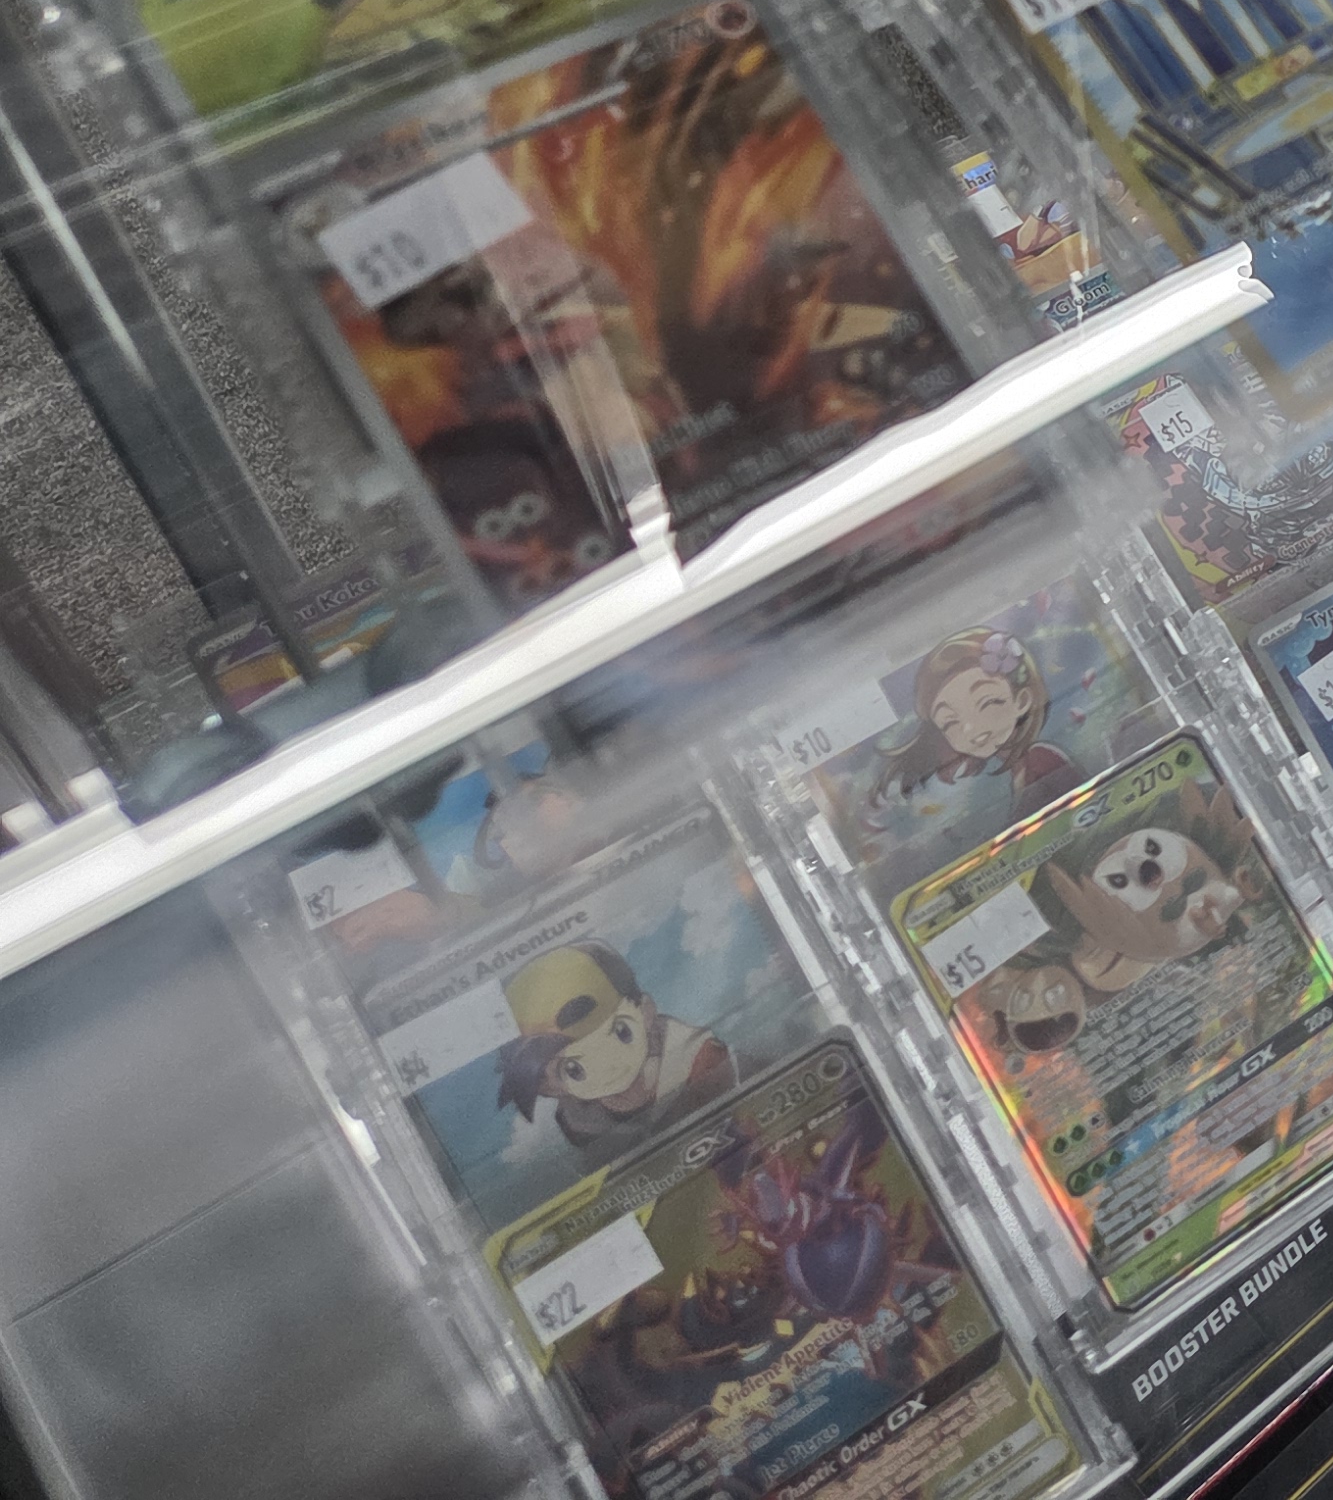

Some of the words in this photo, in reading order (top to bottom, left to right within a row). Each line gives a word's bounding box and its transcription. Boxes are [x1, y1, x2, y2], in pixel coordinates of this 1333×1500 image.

[1156, 408, 1194, 448] $15
[1225, 562, 1265, 588] Ability
[791, 726, 834, 767] $10
[1130, 760, 1176, 800] 270
[473, 905, 592, 982] Adventure
[943, 942, 987, 990] $15
[1238, 1042, 1279, 1079] GX
[680, 1126, 738, 1173] GX
[535, 1278, 586, 1337] $22
[1130, 1303, 1240, 1404] BOOSTER
[1237, 1217, 1330, 1308] BUNDLE
[838, 1423, 888, 1468] Order
[885, 1393, 928, 1434] GX
